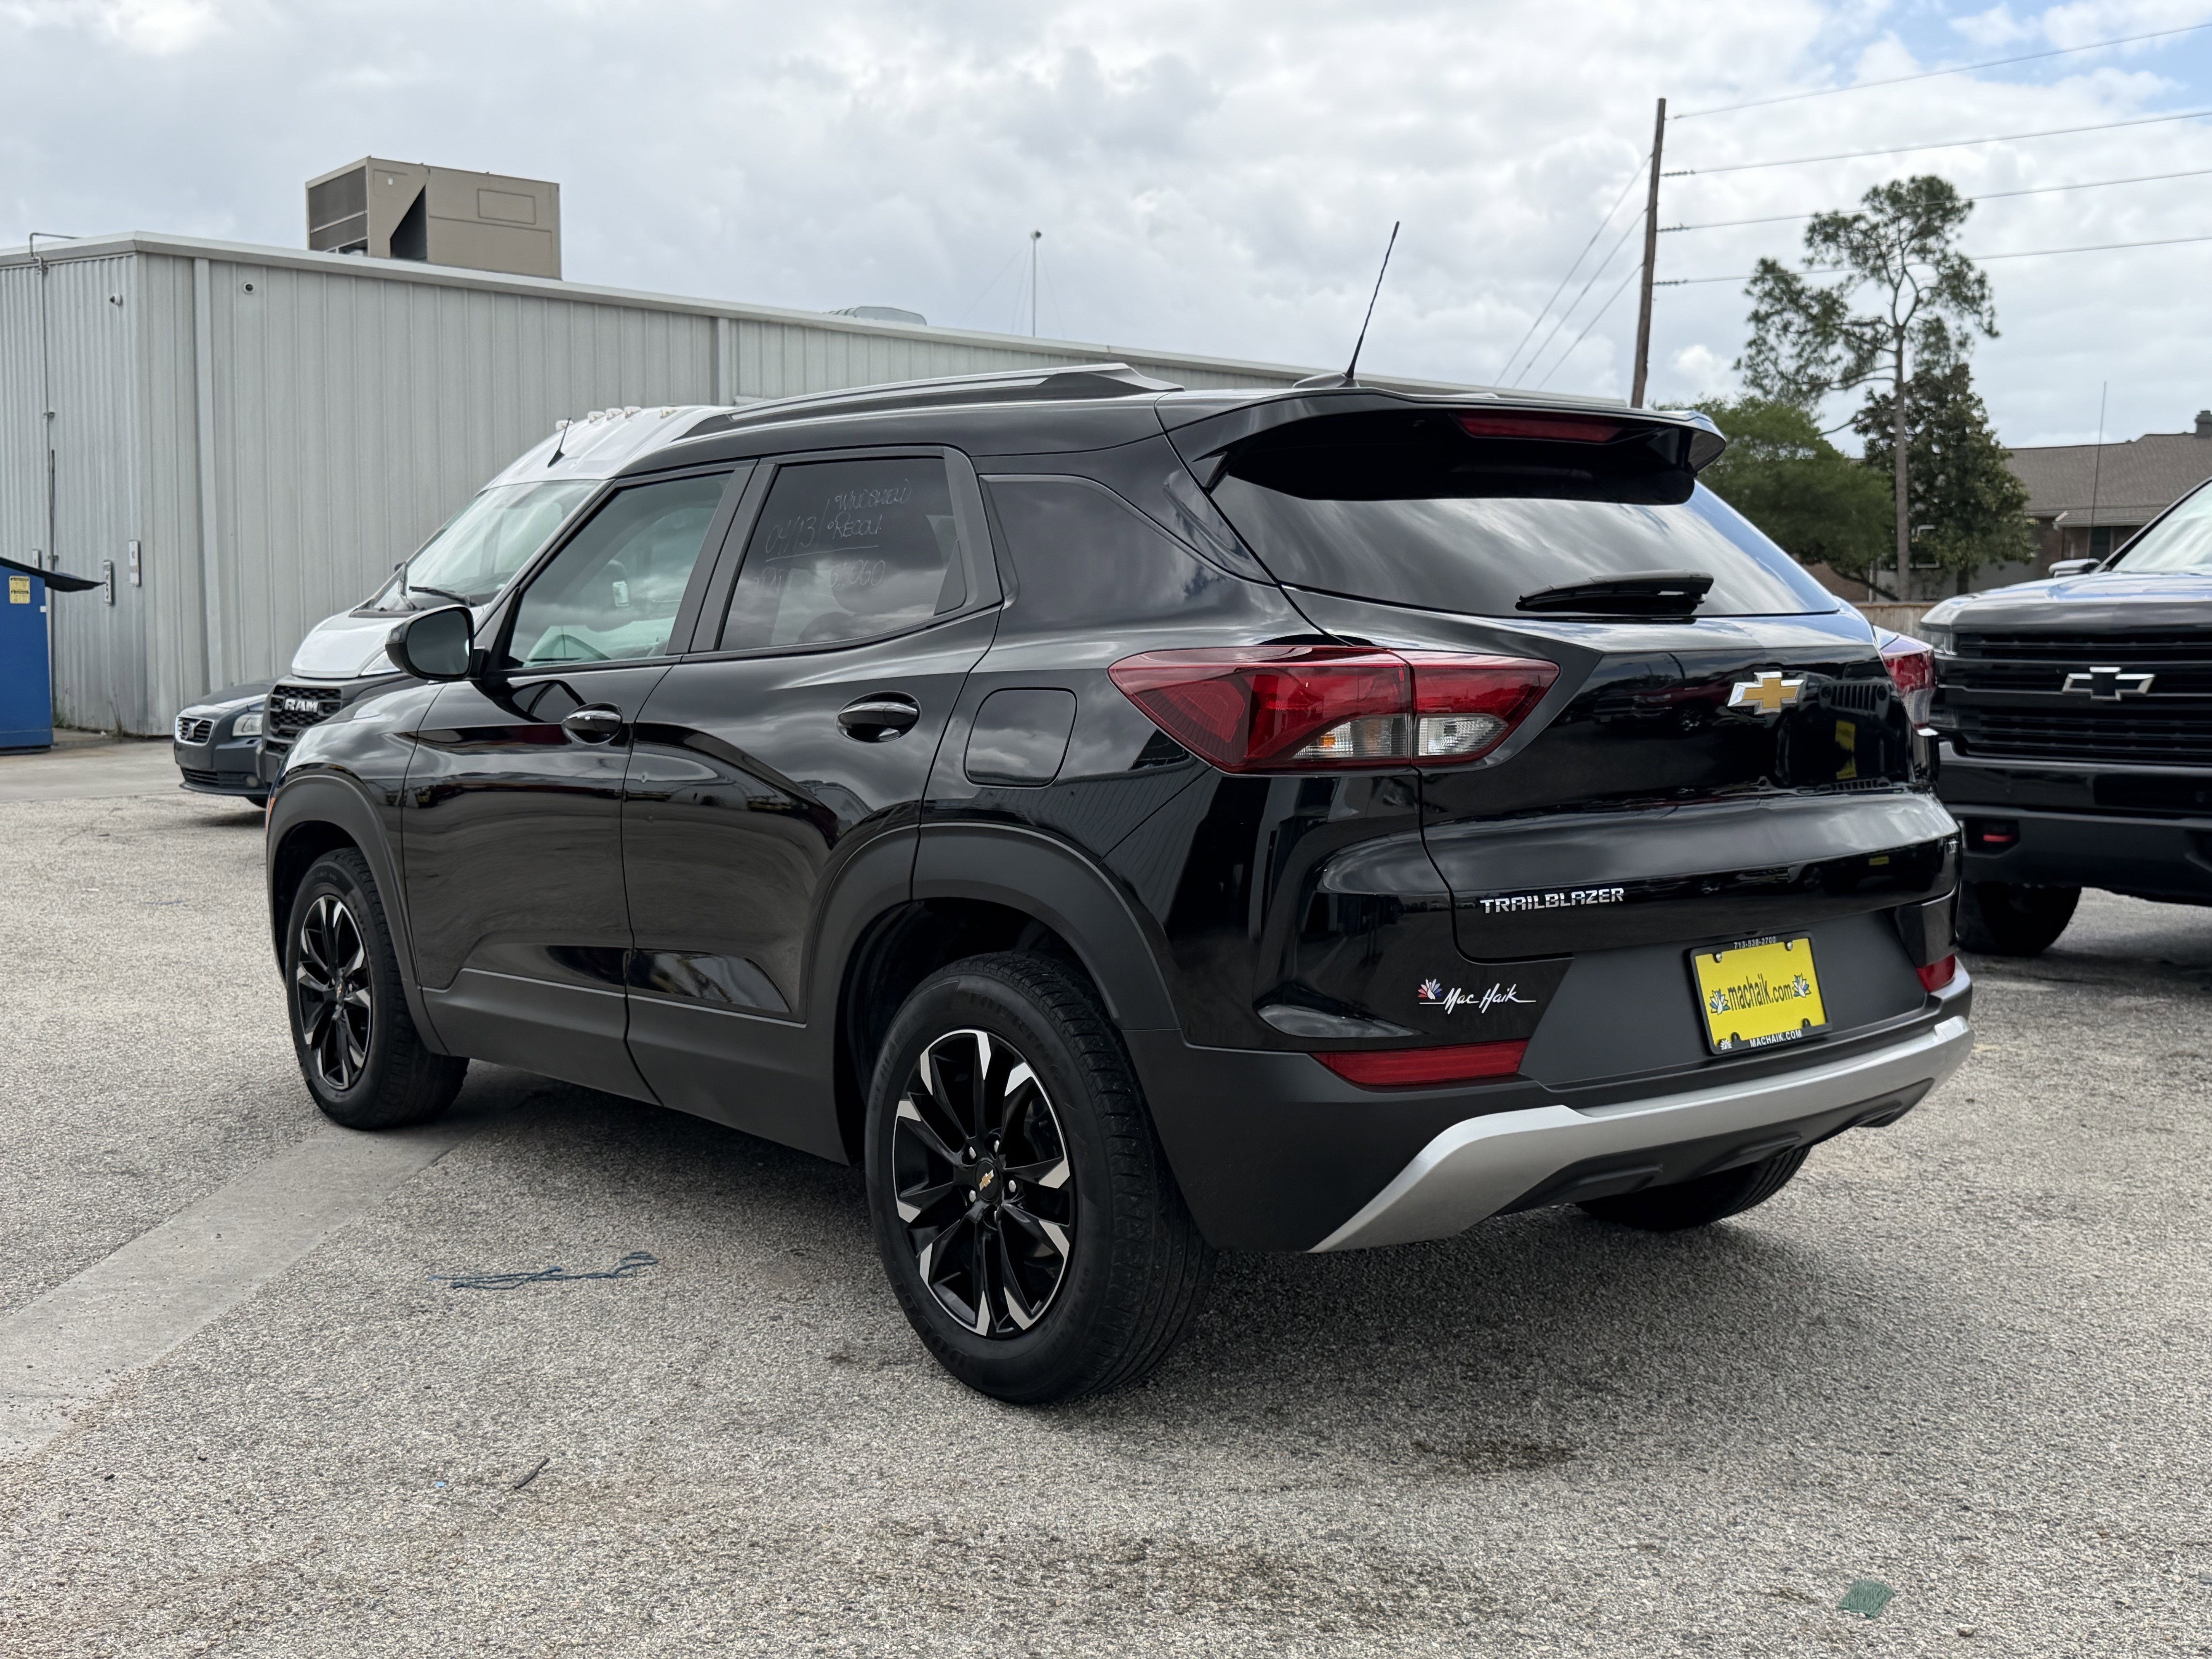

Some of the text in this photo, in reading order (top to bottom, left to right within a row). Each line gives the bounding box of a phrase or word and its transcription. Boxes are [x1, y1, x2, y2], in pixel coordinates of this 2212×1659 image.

[285, 699, 319, 713] RAM
[1480, 888, 1624, 914] TRAILBLAZER
[1419, 983, 1536, 1015] Mac Haik
[1727, 973, 1794, 1011] machaik.com
[1749, 1029, 1802, 1048] MACHAIK.COM
